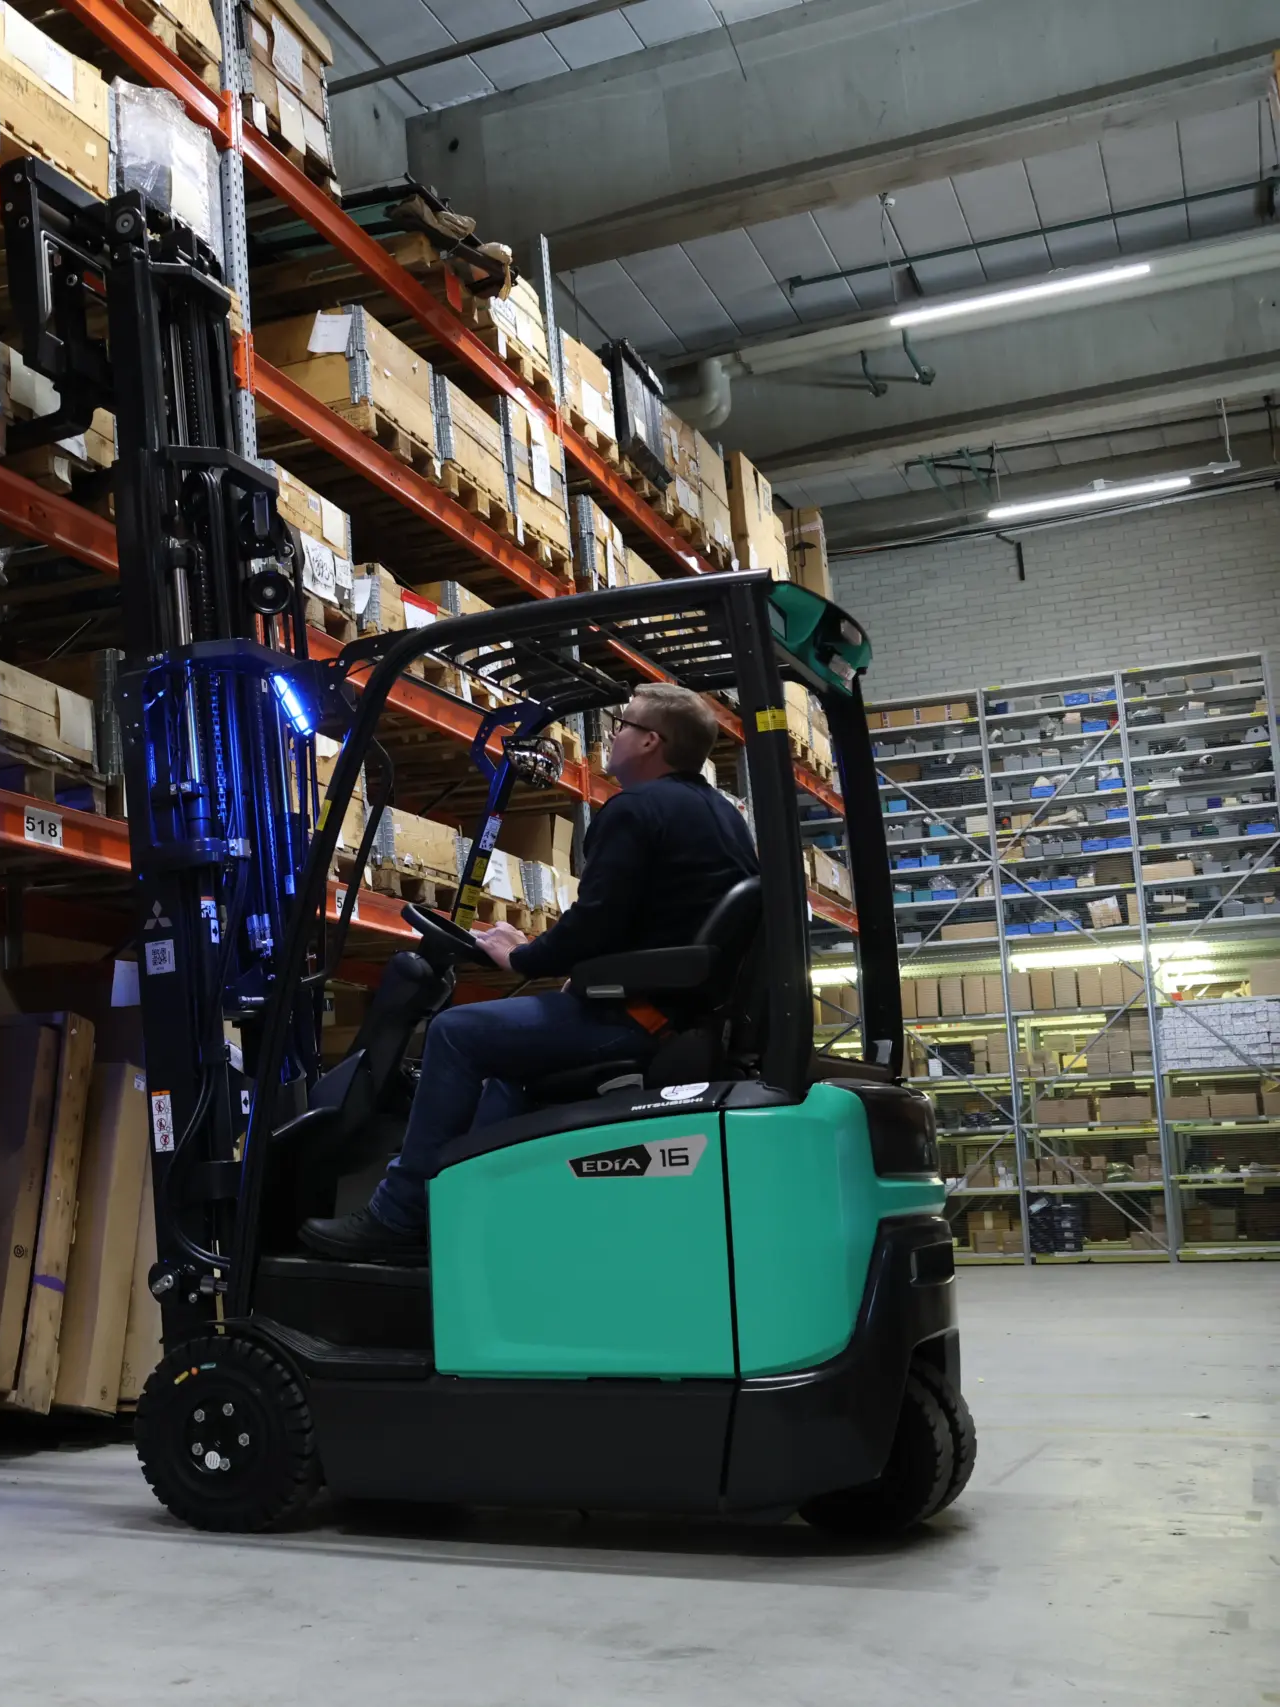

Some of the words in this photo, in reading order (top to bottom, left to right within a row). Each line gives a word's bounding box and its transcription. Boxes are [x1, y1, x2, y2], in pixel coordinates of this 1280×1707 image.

[26, 816, 57, 837] 518
[631, 1097, 704, 1111] MITSUBISHI
[660, 1147, 689, 1167] 16
